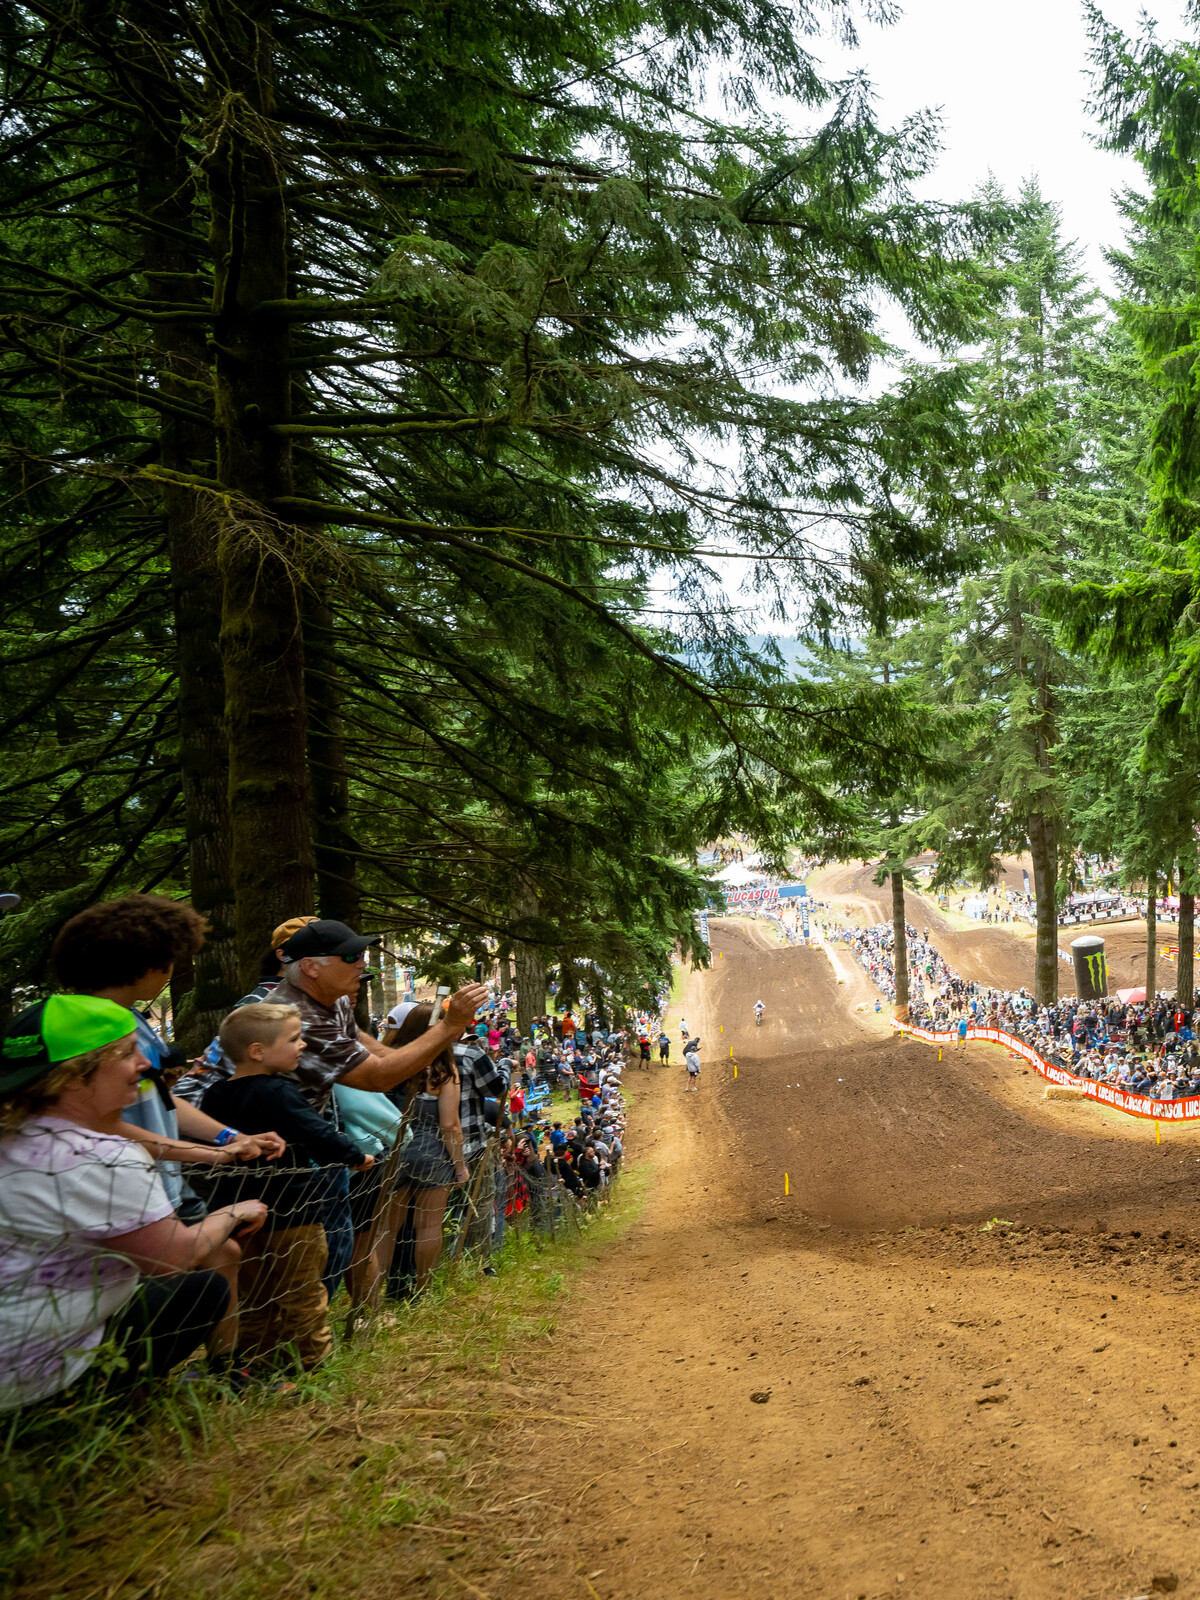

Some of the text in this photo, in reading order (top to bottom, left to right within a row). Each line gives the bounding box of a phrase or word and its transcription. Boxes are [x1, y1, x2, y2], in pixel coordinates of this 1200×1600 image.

[727, 888, 779, 903] LUCAS OIL
[1153, 1102, 1173, 1119] LUCAS
[1173, 1103, 1184, 1118] OIL
